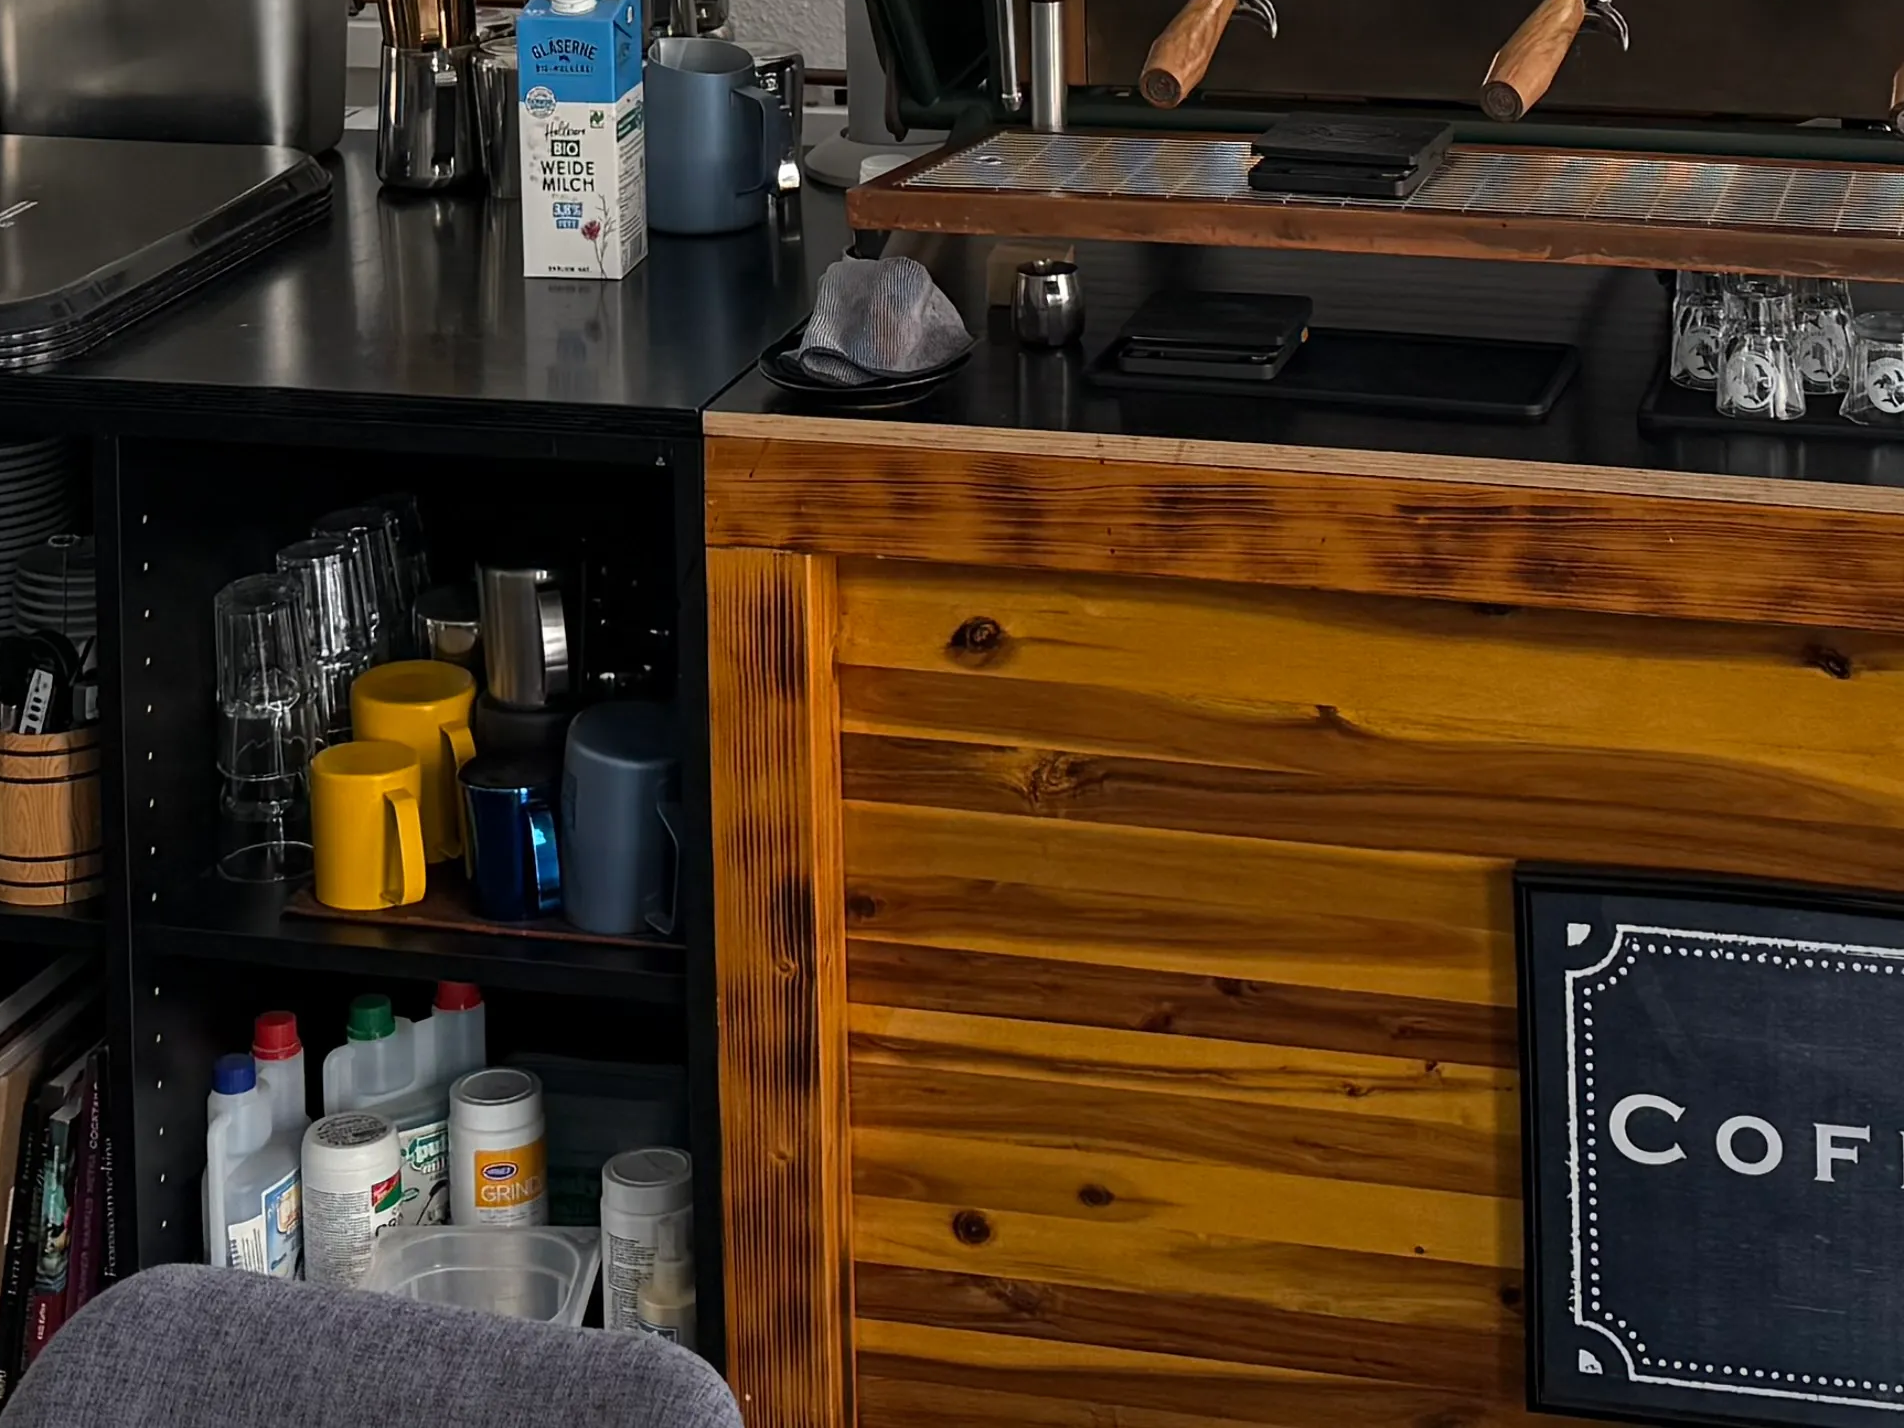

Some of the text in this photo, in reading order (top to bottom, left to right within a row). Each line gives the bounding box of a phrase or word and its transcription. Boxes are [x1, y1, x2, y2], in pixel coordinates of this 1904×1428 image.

[531, 37, 599, 61] GLÄSERNE
[553, 141, 579, 156] BIO
[541, 161, 595, 175] WEIDE
[542, 177, 595, 193] MILCH
